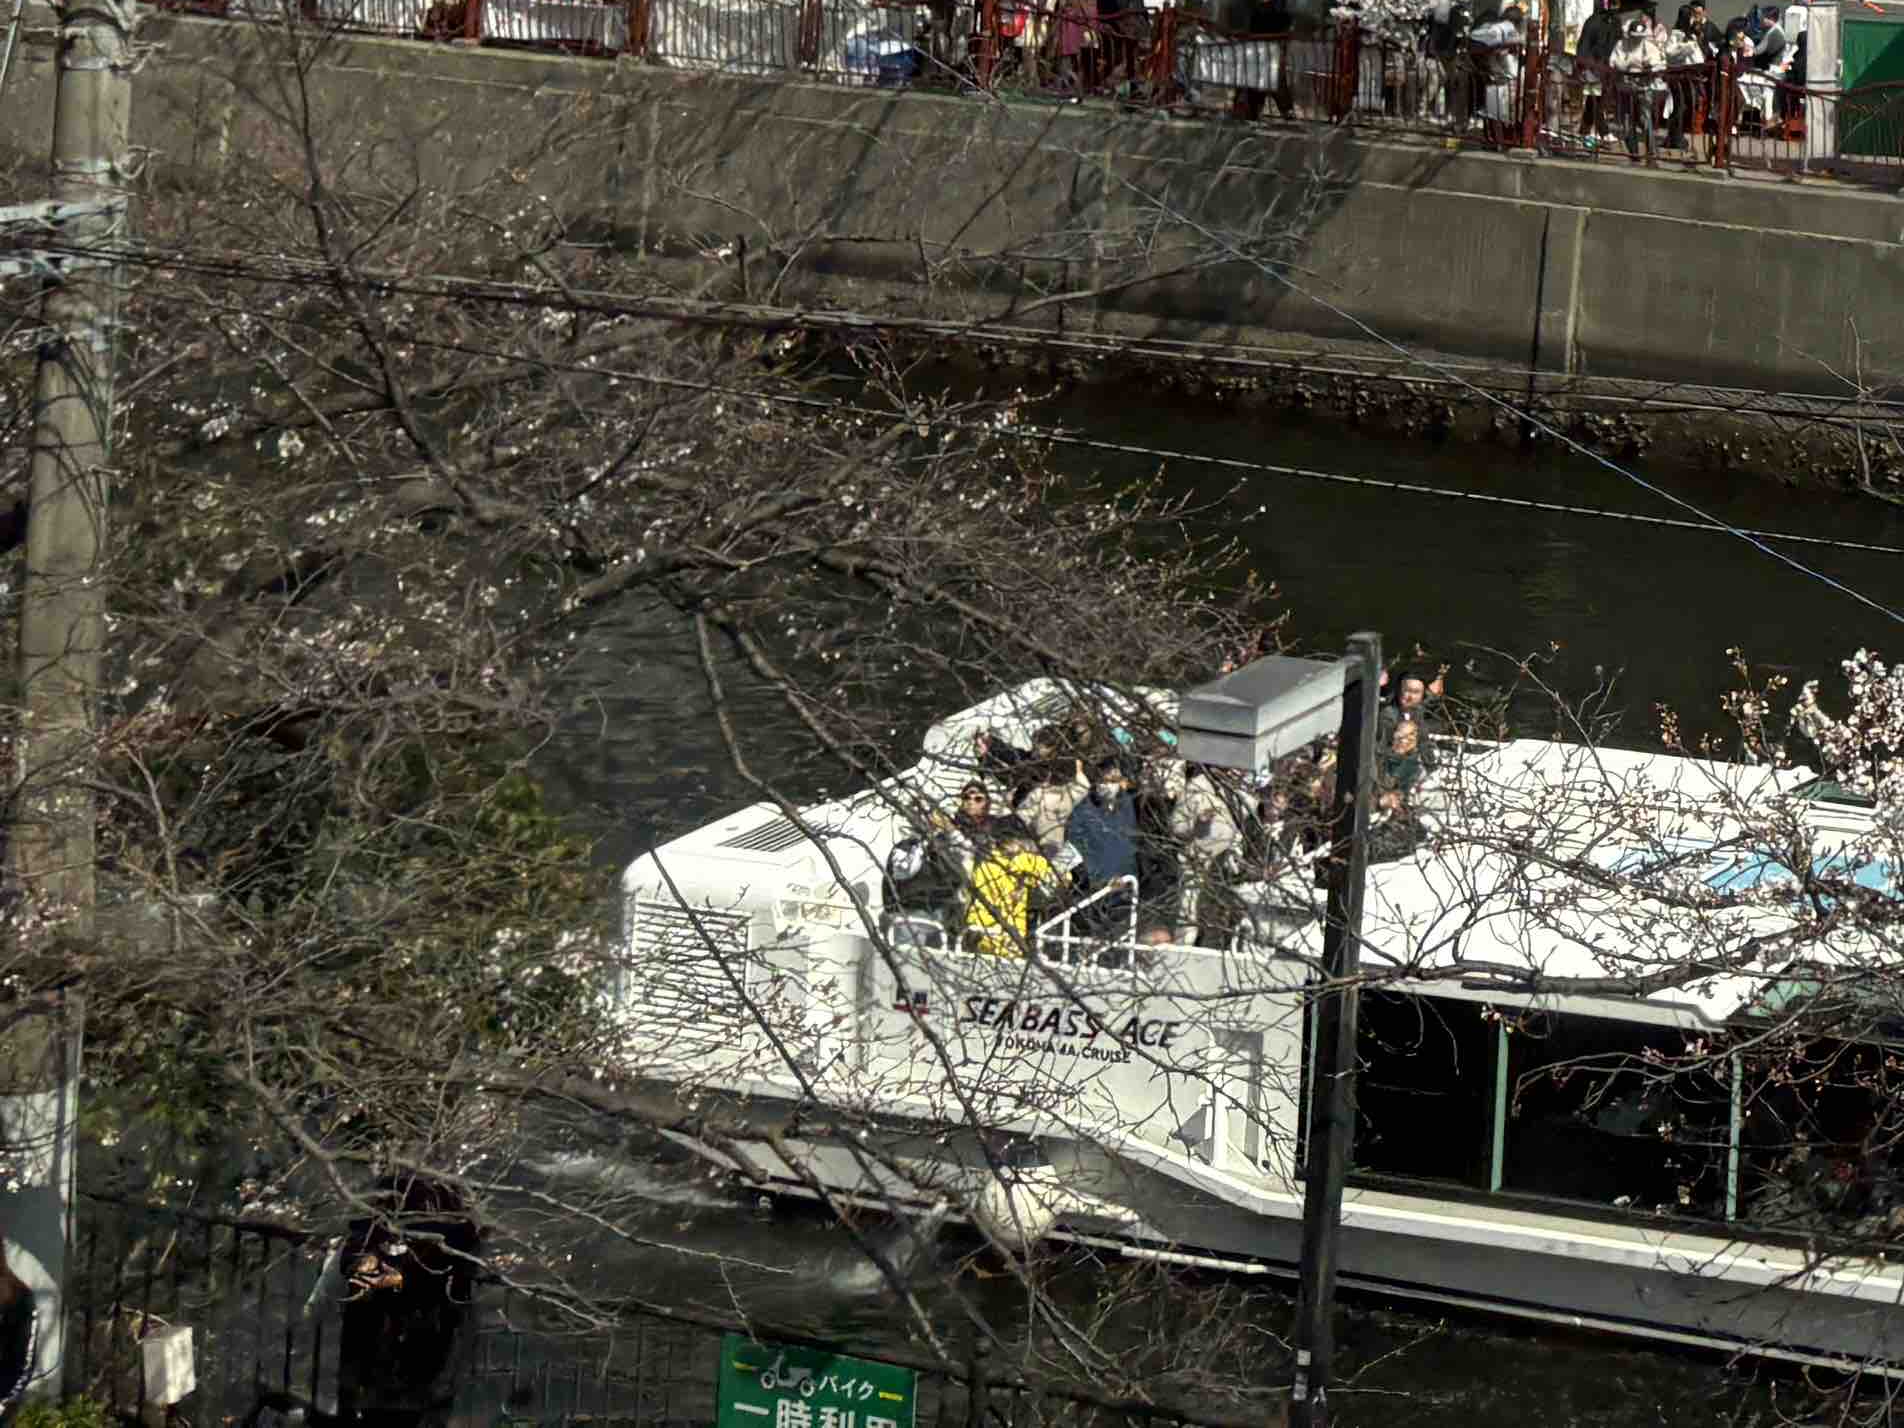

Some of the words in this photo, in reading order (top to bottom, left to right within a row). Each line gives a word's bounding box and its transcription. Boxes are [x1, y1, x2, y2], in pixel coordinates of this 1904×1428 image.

[1120, 1017, 1182, 1049] ACE
[1082, 1046, 1132, 1064] CRUISE
[818, 1375, 875, 1401] バイク
